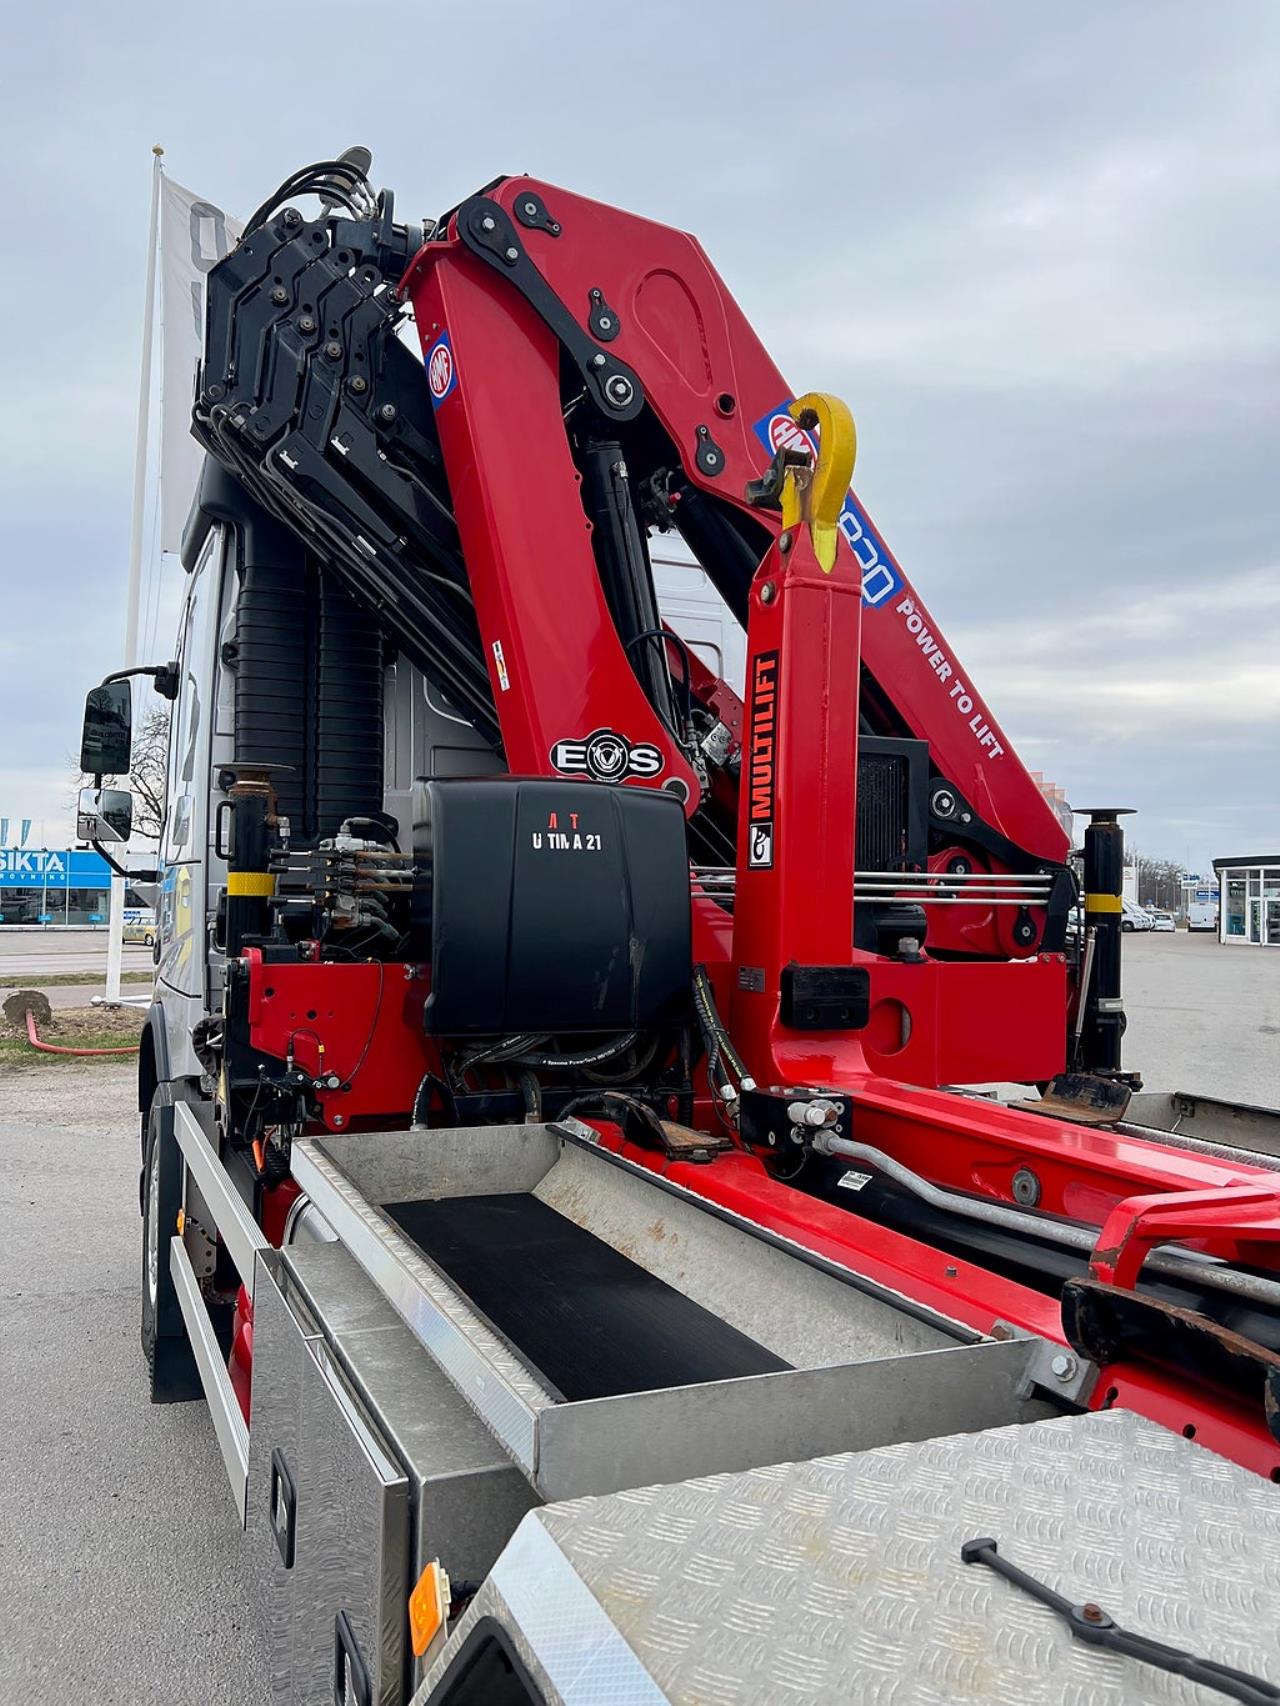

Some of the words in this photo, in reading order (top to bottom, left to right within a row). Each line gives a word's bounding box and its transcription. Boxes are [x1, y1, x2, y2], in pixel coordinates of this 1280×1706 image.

[773, 420, 812, 453] HM
[896, 599, 953, 683] POWER
[949, 679, 974, 714] TO
[969, 714, 1004, 759] LIFT
[751, 658, 776, 819] MULTILIFT
[586, 834, 602, 850] 21
